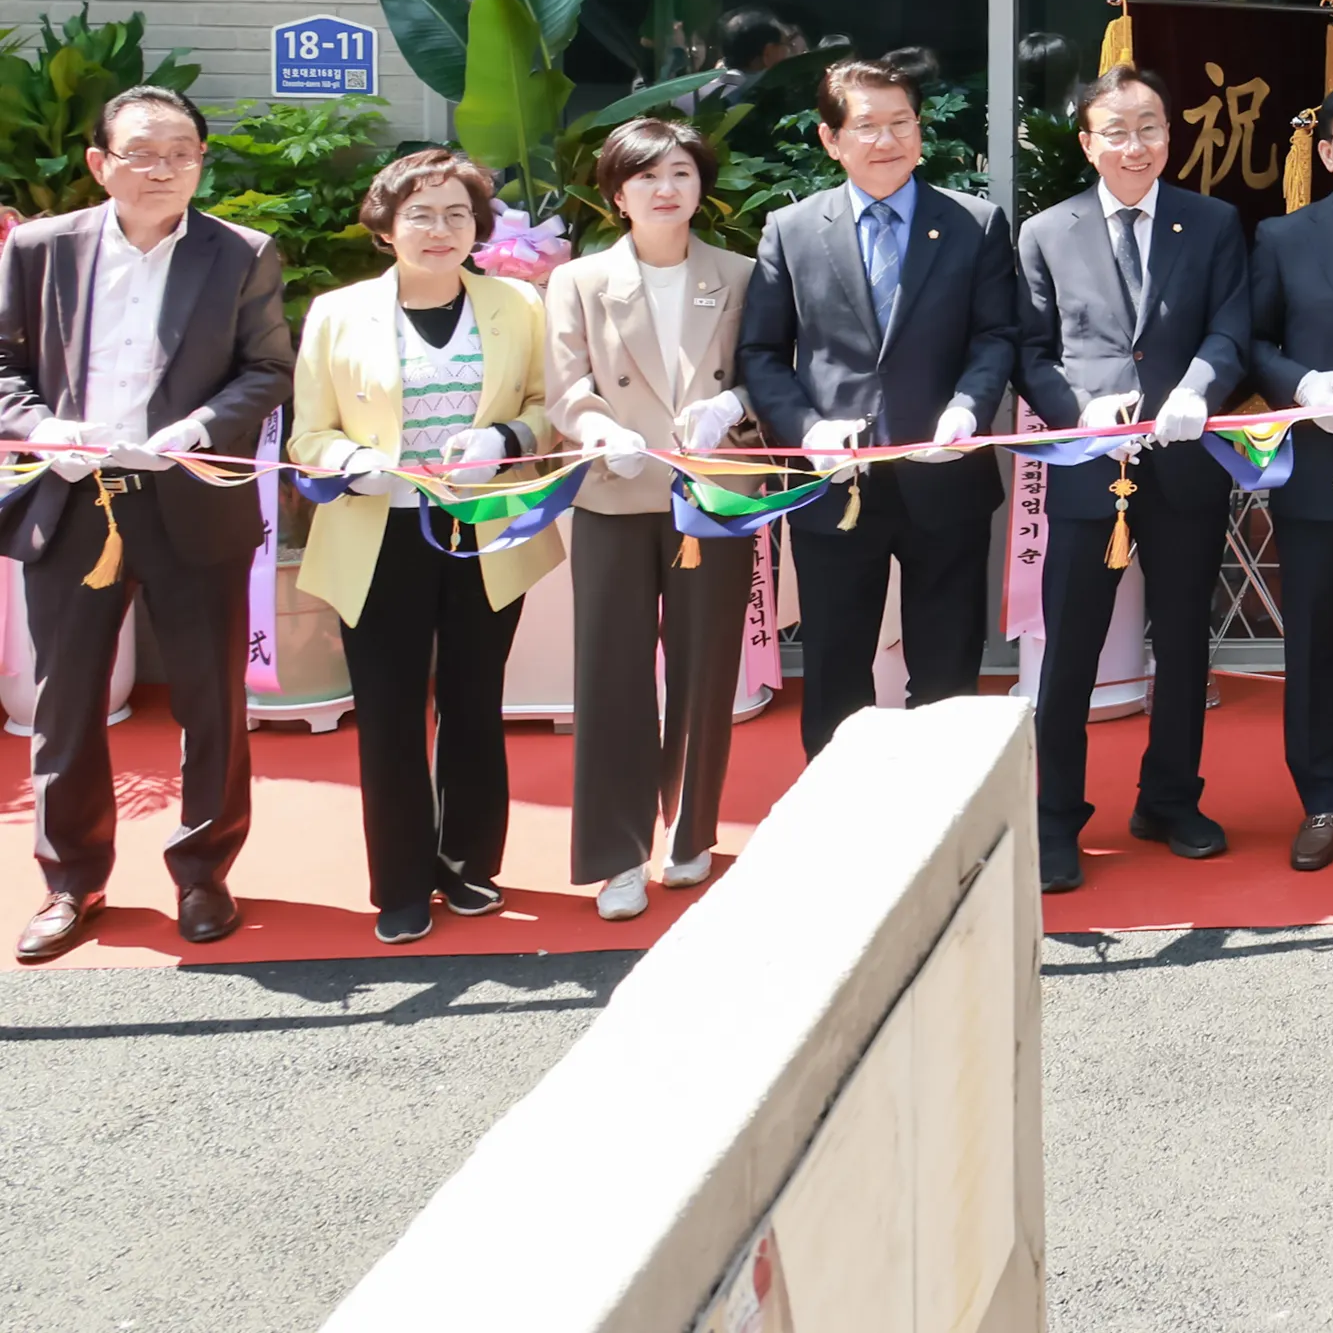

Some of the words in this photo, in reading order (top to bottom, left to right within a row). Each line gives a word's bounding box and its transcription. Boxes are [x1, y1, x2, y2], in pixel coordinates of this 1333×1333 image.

[283, 30, 364, 60] 18-11
[282, 68, 342, 80] 천호대로168길
[1177, 61, 1280, 198] 祝
